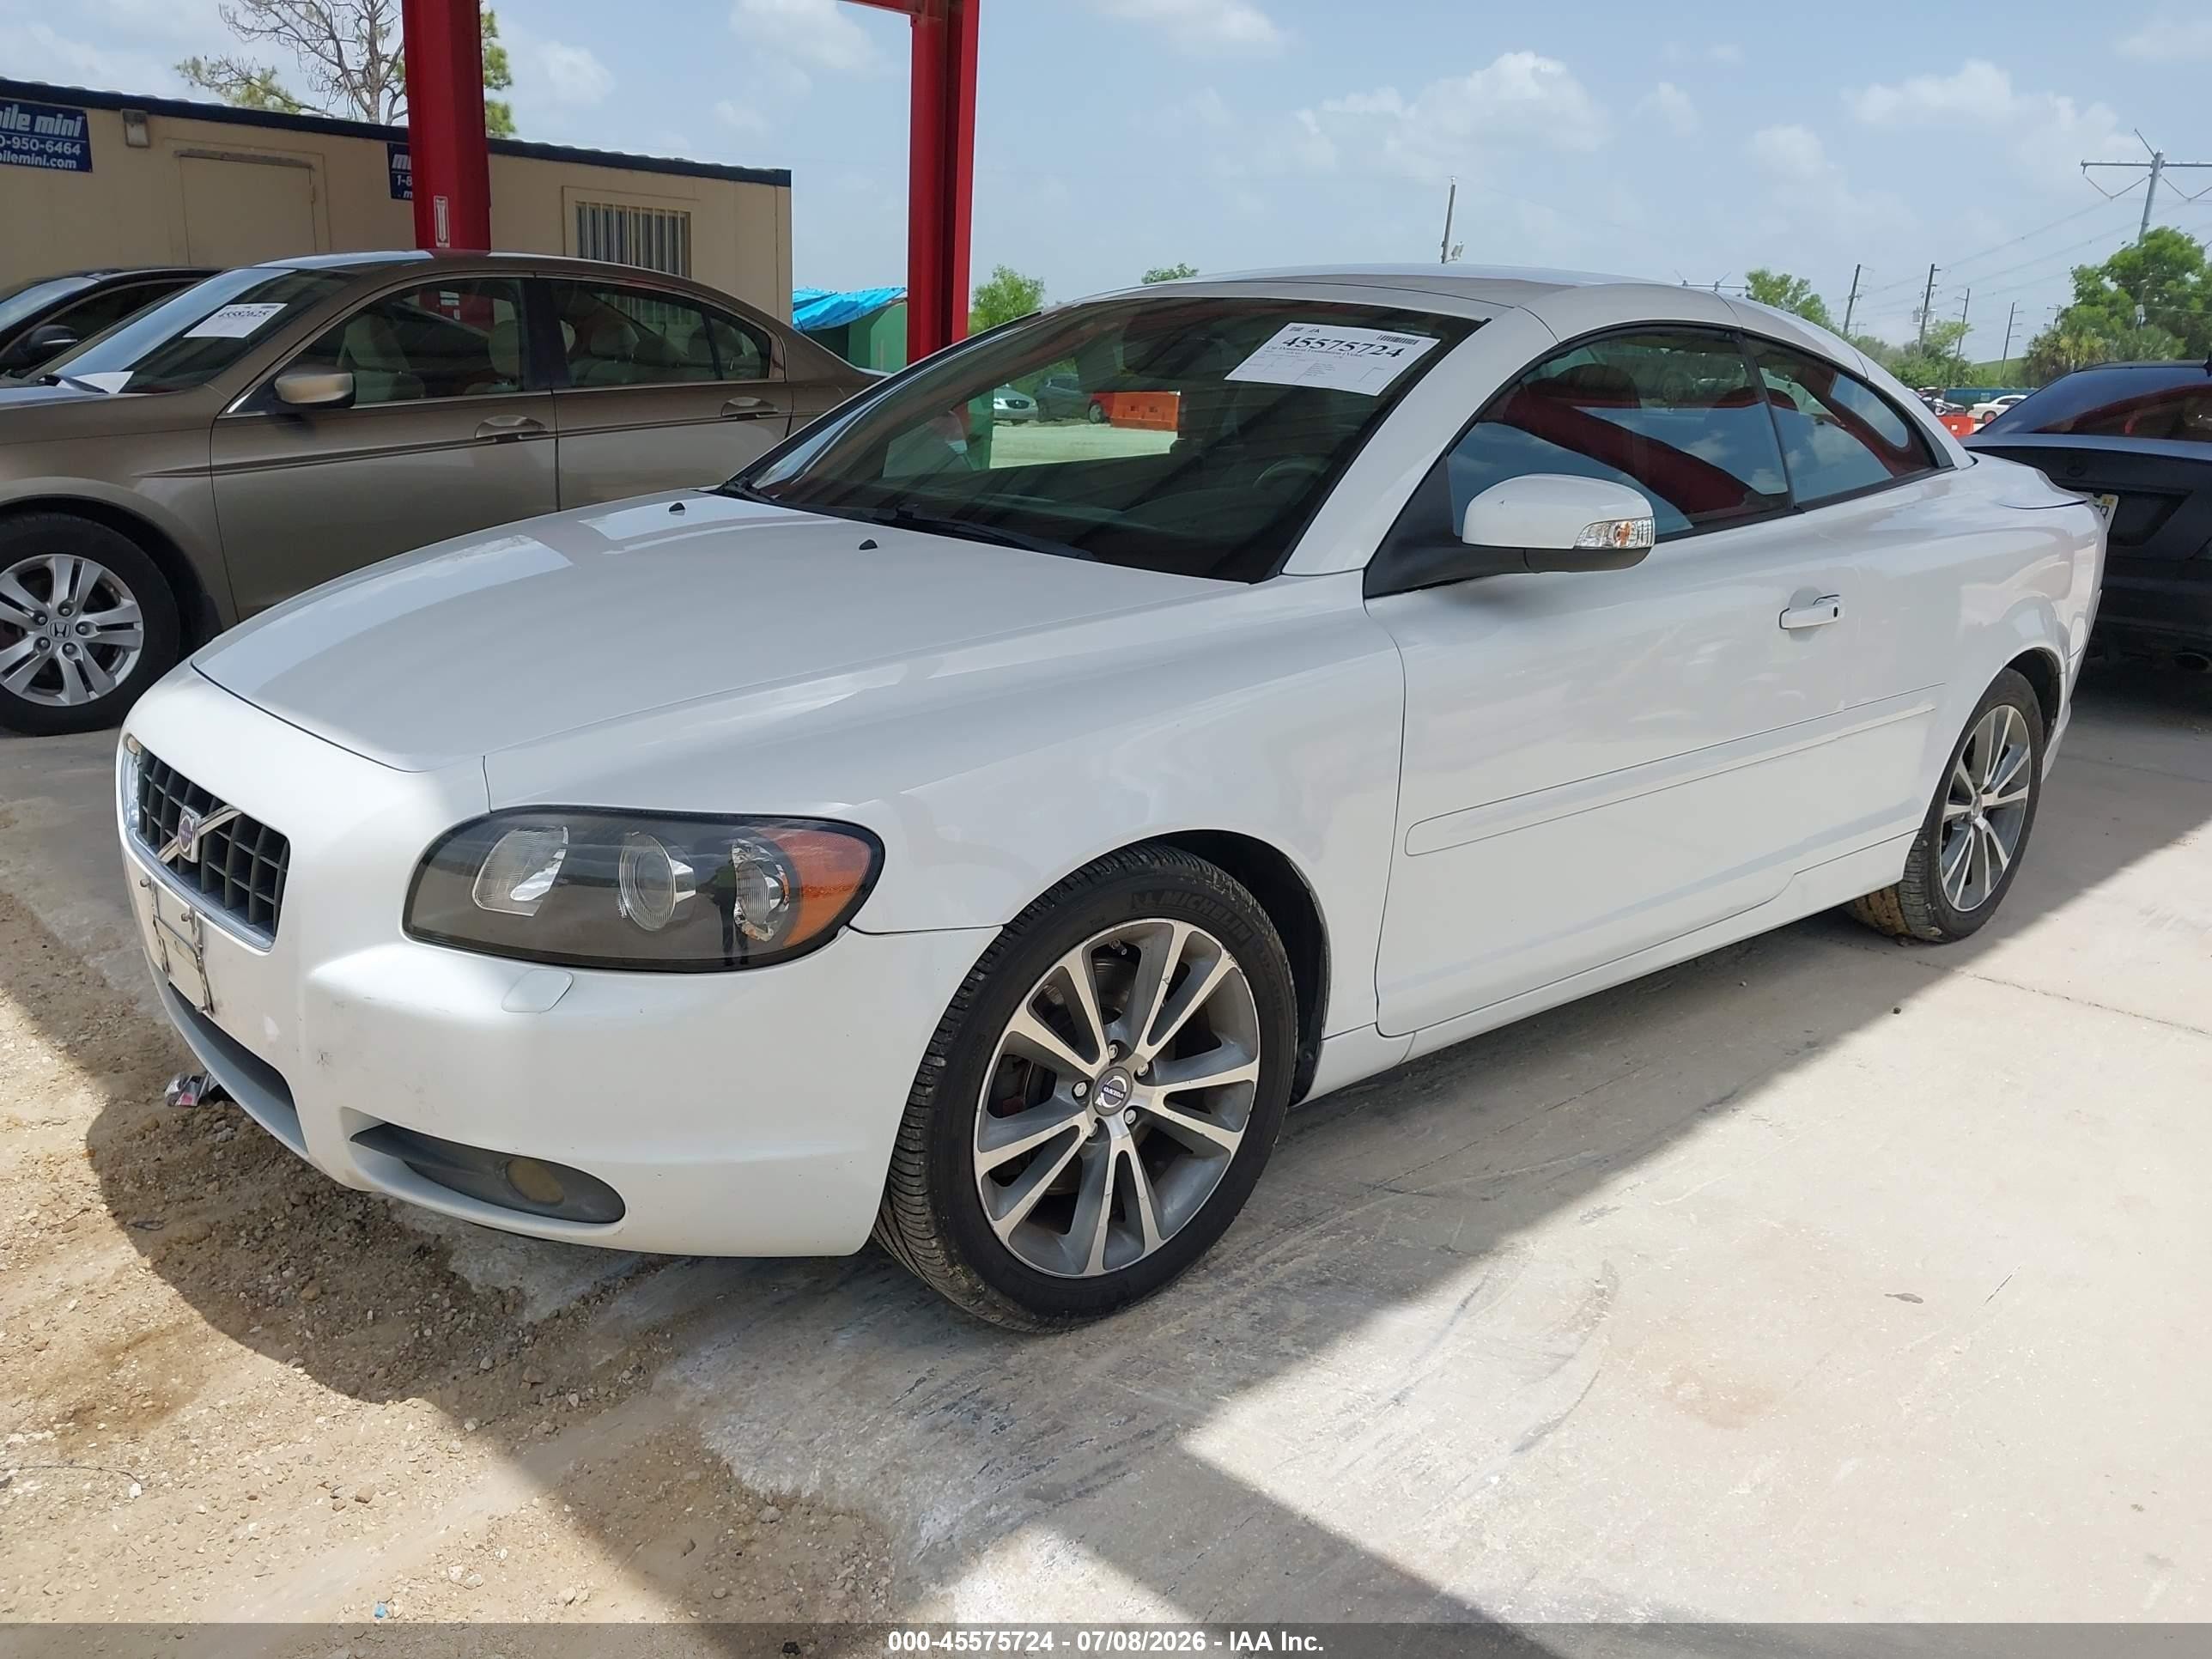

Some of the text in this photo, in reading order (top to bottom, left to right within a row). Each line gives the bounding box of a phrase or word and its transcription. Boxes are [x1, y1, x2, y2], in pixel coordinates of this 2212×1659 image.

[0, 104, 82, 137] ile mini
[0, 150, 76, 168] ilemini.com
[1282, 336, 1406, 358] 45575724
[1159, 890, 1252, 944] MICHELIN
